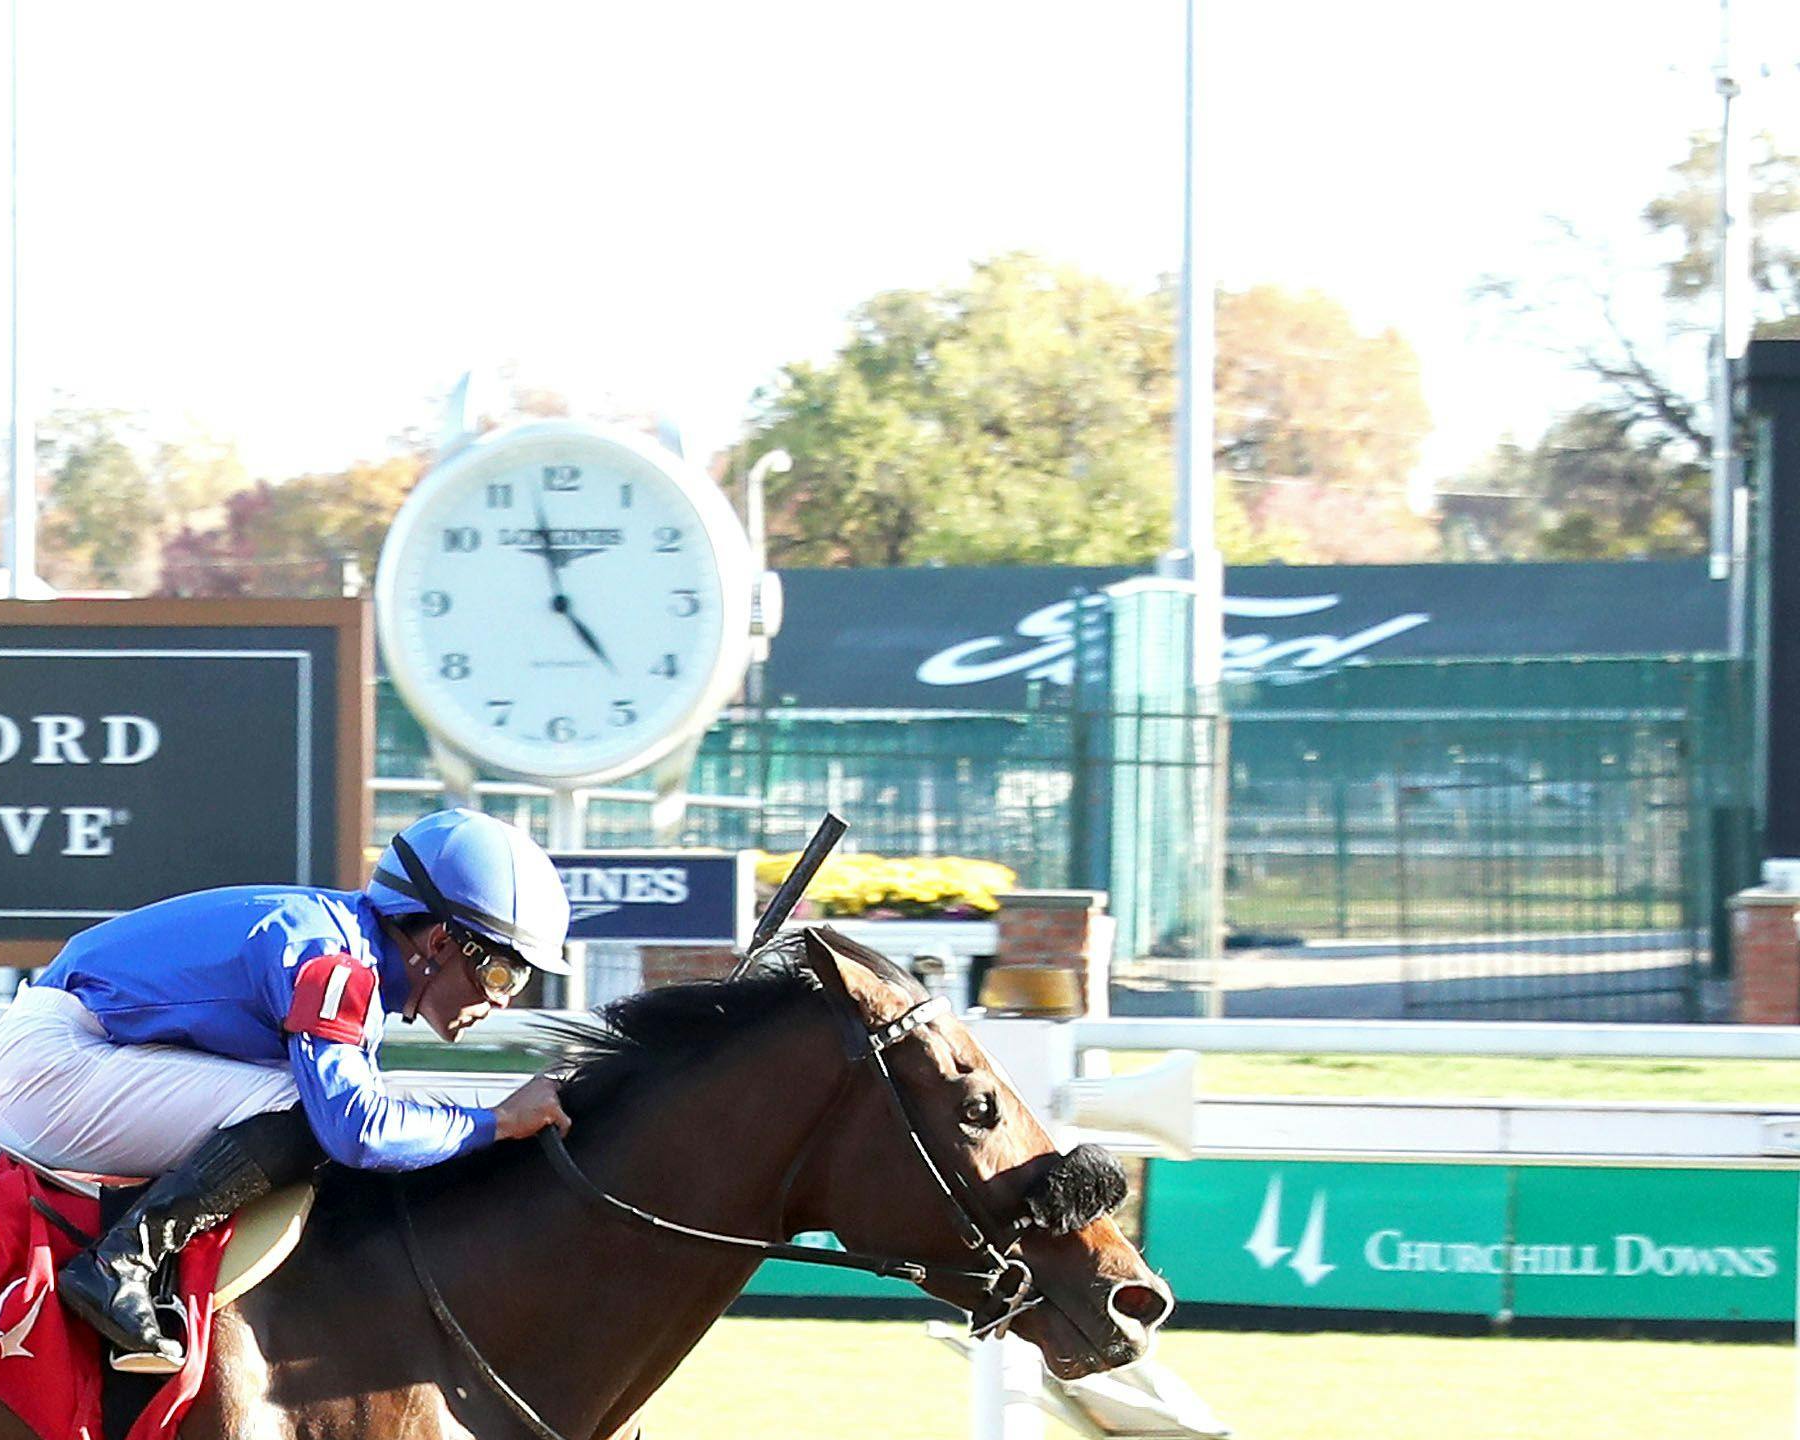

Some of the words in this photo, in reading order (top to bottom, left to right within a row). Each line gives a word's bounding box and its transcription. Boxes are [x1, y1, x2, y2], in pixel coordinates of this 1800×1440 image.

[543, 465, 581, 492] 12
[486, 483, 512, 509] 11
[620, 484, 632, 508] 1
[443, 526, 481, 553] 10
[652, 526, 684, 553] 2
[420, 590, 450, 617] 9
[667, 589, 701, 617] 3
[439, 653, 470, 681] 8
[650, 653, 680, 681] 4
[487, 700, 512, 728] 7
[612, 701, 638, 728] 5
[546, 716, 577, 743] 6
[319, 964, 352, 1021] 1
[1364, 1230, 1606, 1275] CHURCHILL
[1613, 1234, 1779, 1278] DOWNS
